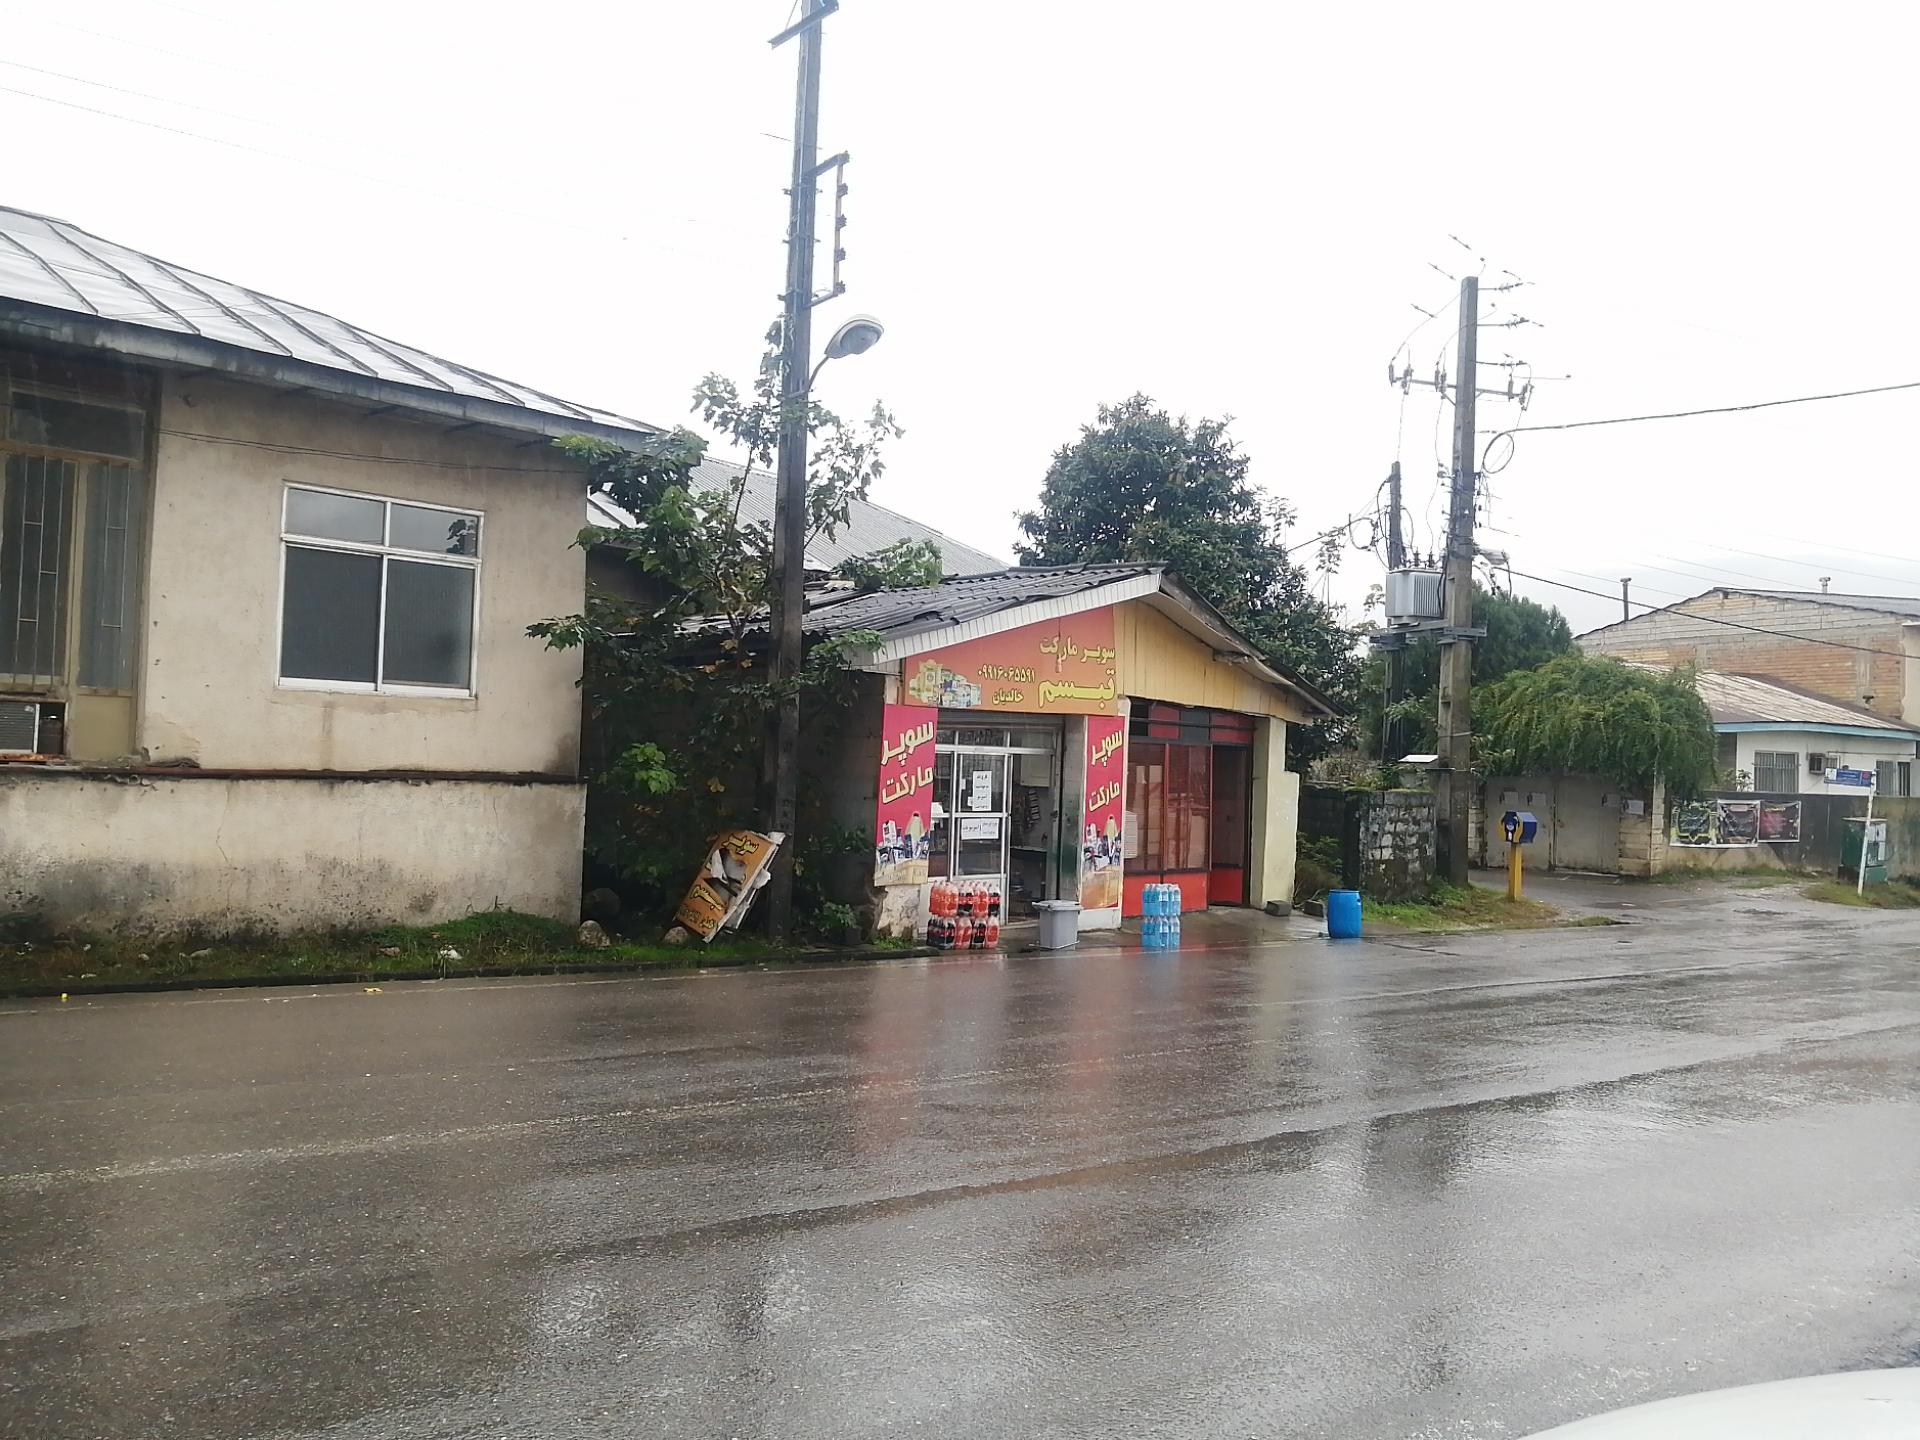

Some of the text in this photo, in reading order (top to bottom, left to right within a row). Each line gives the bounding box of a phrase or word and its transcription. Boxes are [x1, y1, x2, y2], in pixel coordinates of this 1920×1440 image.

[1040, 636, 1116, 664] سوپر مارکت
[1038, 669, 1116, 708] تبسم
[881, 721, 934, 766] سوپر
[1091, 730, 1123, 767] سوپر
[882, 765, 934, 804] مارکت
[1088, 780, 1121, 812] مارکت
